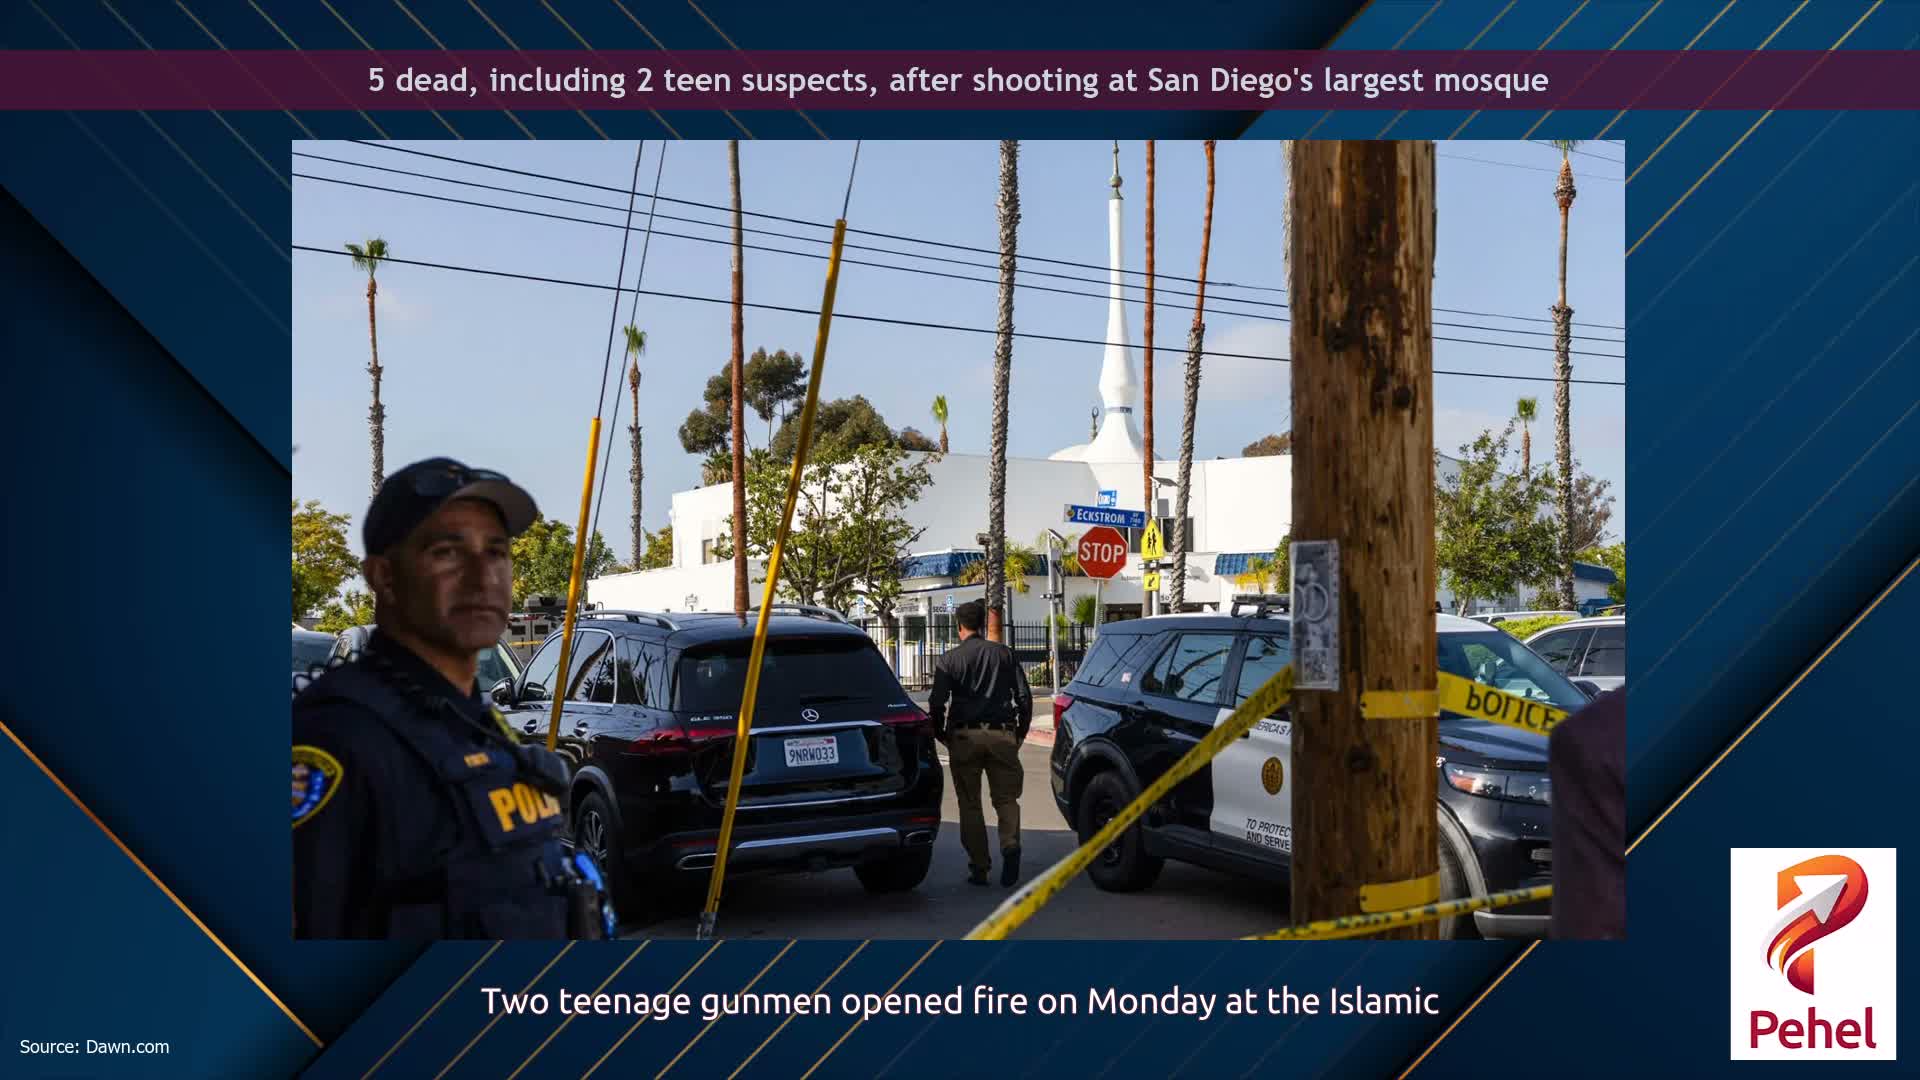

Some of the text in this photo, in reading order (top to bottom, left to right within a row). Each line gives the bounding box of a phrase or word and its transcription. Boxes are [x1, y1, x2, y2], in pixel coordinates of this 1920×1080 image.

[1076, 508, 1126, 525] ECKSTROM
[1080, 541, 1125, 563] STOP
[1246, 818, 1292, 838] TO PROTEC
[1246, 831, 1291, 851] AND SERVE
